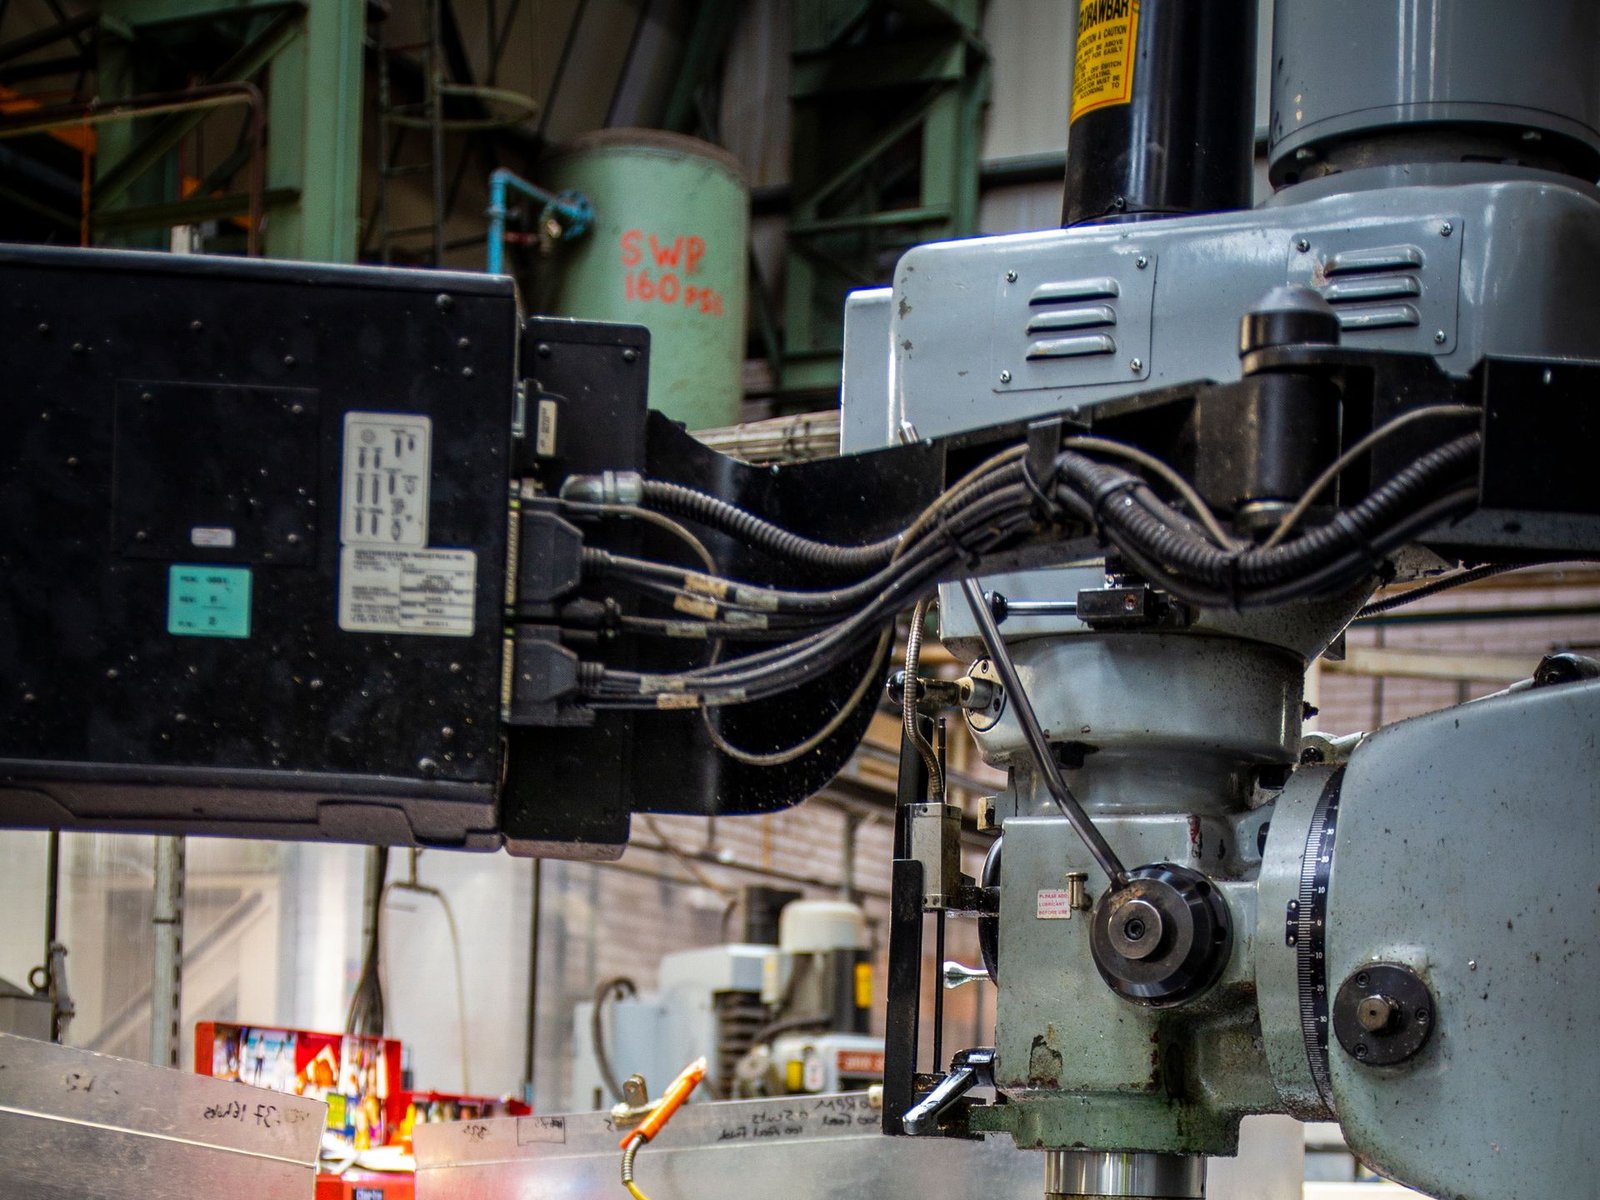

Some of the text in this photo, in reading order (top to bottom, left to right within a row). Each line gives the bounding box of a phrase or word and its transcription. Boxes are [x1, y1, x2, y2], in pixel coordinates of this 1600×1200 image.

[1104, 25, 1127, 38] CAUTION
[1105, 39, 1123, 48] ABOVE
[1104, 46, 1122, 55] EASILY
[1101, 61, 1122, 71] SWITCH
[1096, 75, 1111, 86] MUST
[621, 229, 706, 274] SWP
[625, 268, 680, 304] 160
[1318, 886, 1326, 894] 10
[1316, 919, 1322, 927] 0
[1316, 984, 1325, 992] 20
[1320, 1015, 1328, 1023] 30
